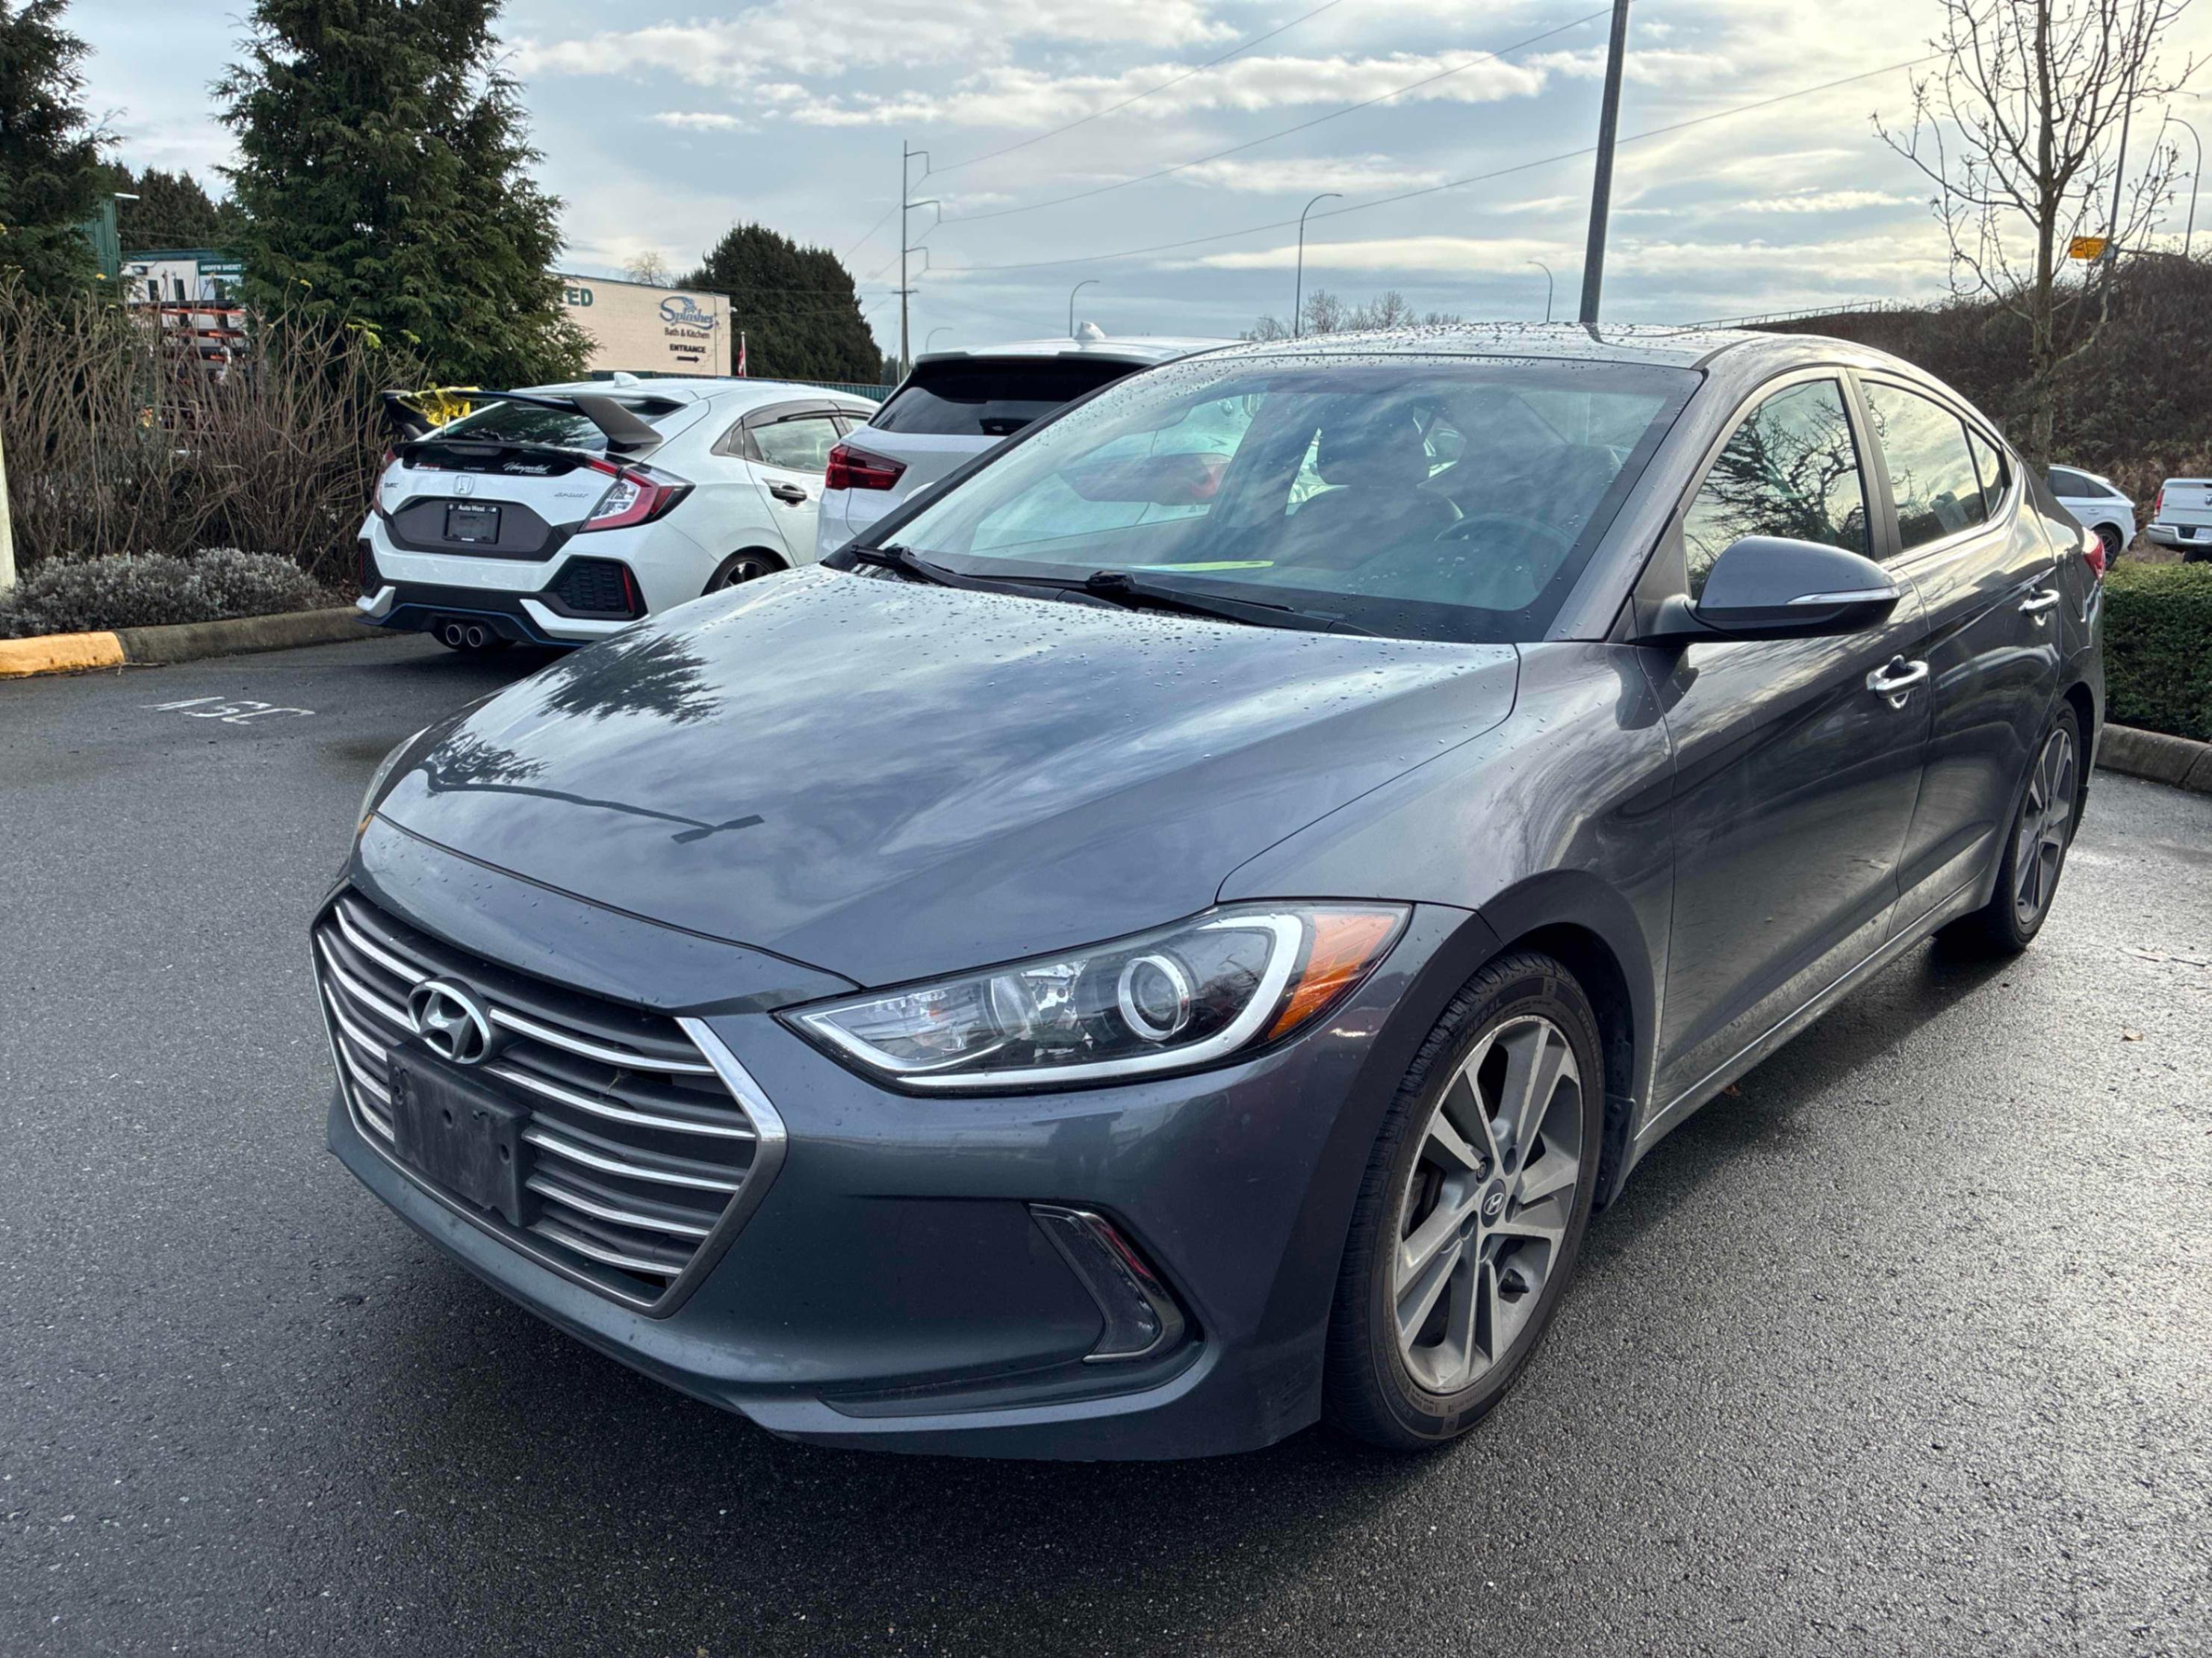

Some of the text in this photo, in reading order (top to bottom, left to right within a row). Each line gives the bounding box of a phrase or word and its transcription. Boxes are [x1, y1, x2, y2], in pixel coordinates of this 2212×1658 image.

[659, 296, 714, 330] Splashes
[665, 327, 680, 337] Bath
[686, 329, 710, 340] Kitchen
[669, 344, 706, 354] ENTRANCE
